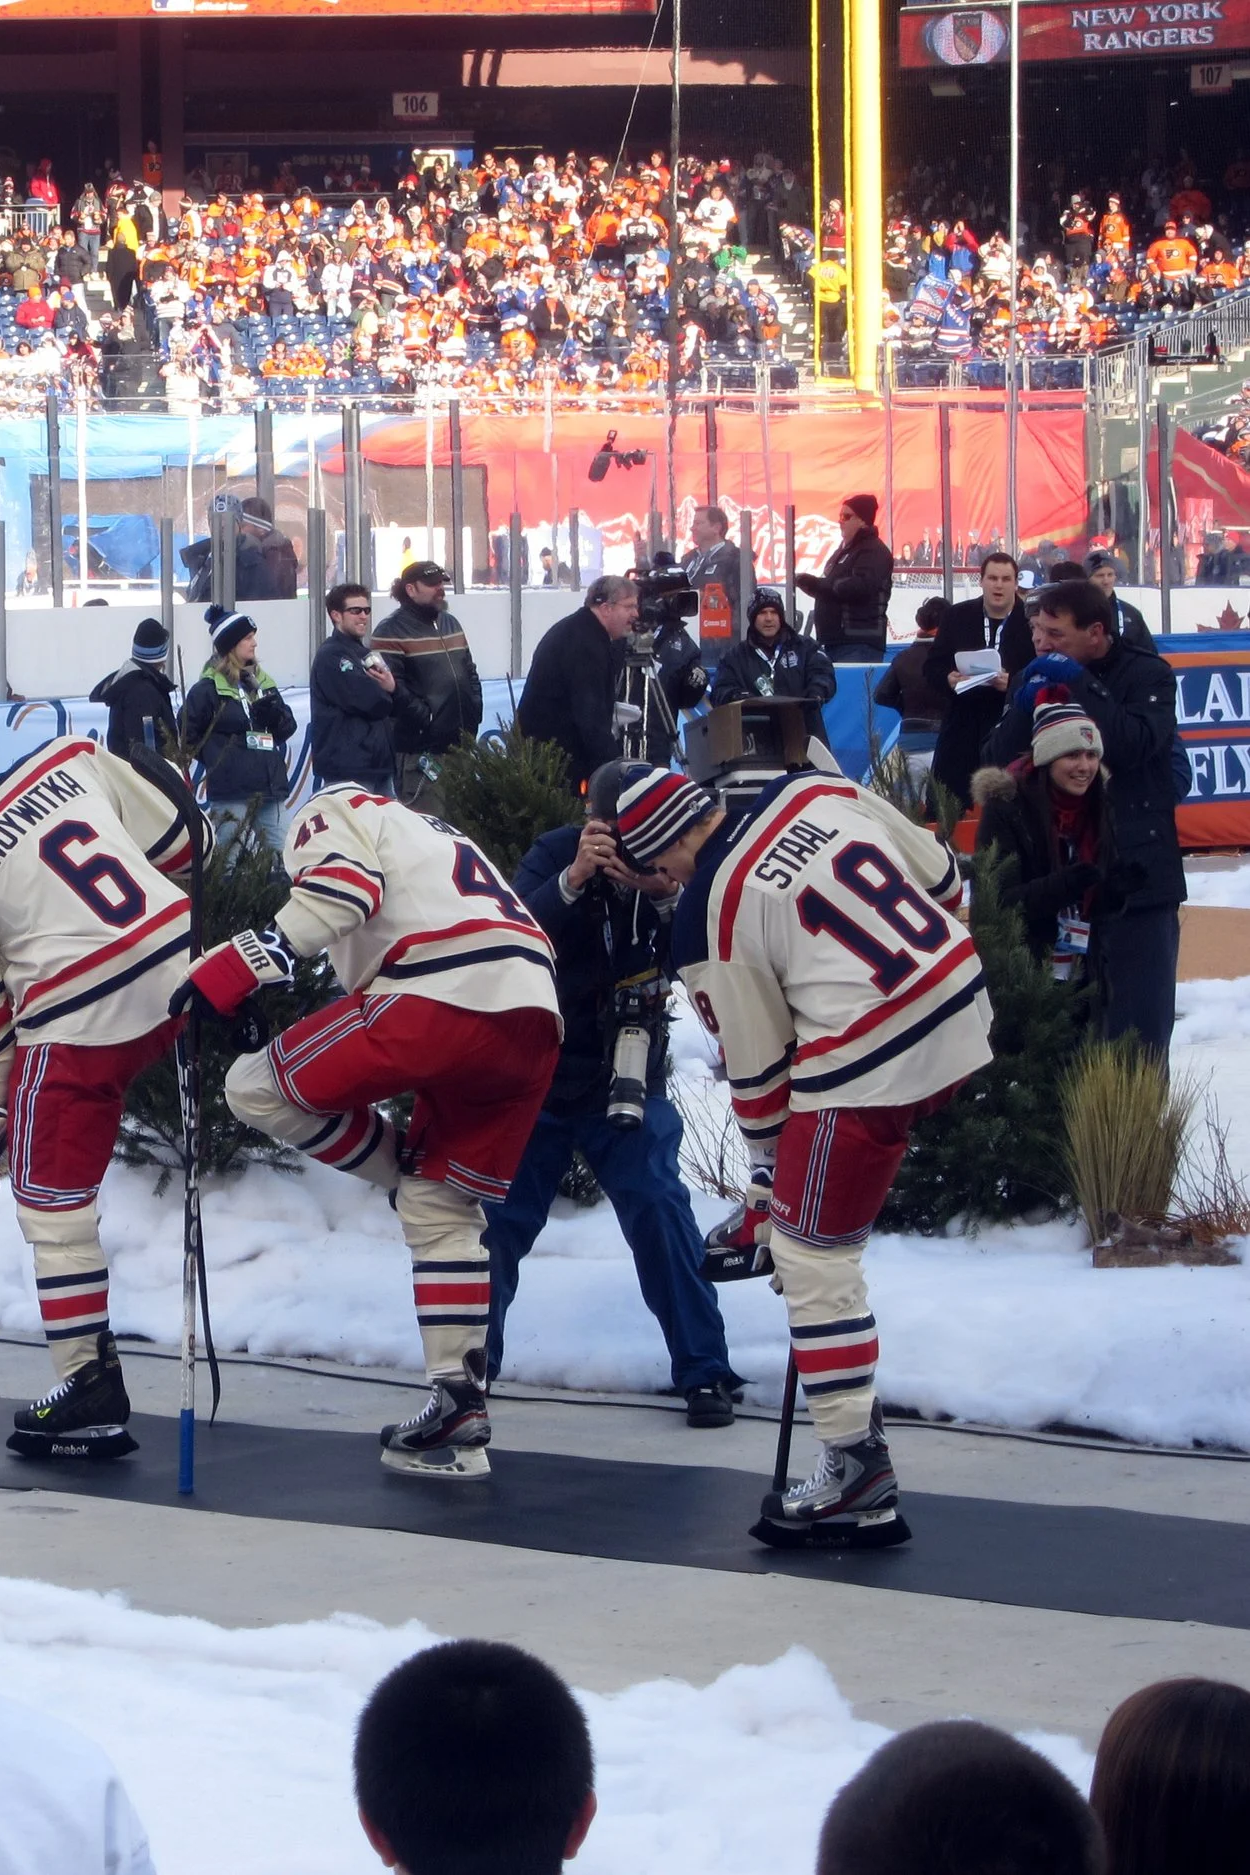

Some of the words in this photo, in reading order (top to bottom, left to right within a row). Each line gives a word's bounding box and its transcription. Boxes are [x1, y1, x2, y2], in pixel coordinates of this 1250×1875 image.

[1071, 8, 1137, 28] NEW
[1144, 1, 1223, 22] YORK
[1084, 26, 1214, 50] RANGERS
[1199, 66, 1221, 85] 107
[403, 96, 428, 113] 106
[293, 812, 329, 852] 41
[755, 819, 840, 889] STAAL
[39, 819, 146, 929] 6
[796, 840, 951, 997] 18
[52, 1444, 89, 1456] Reebok
